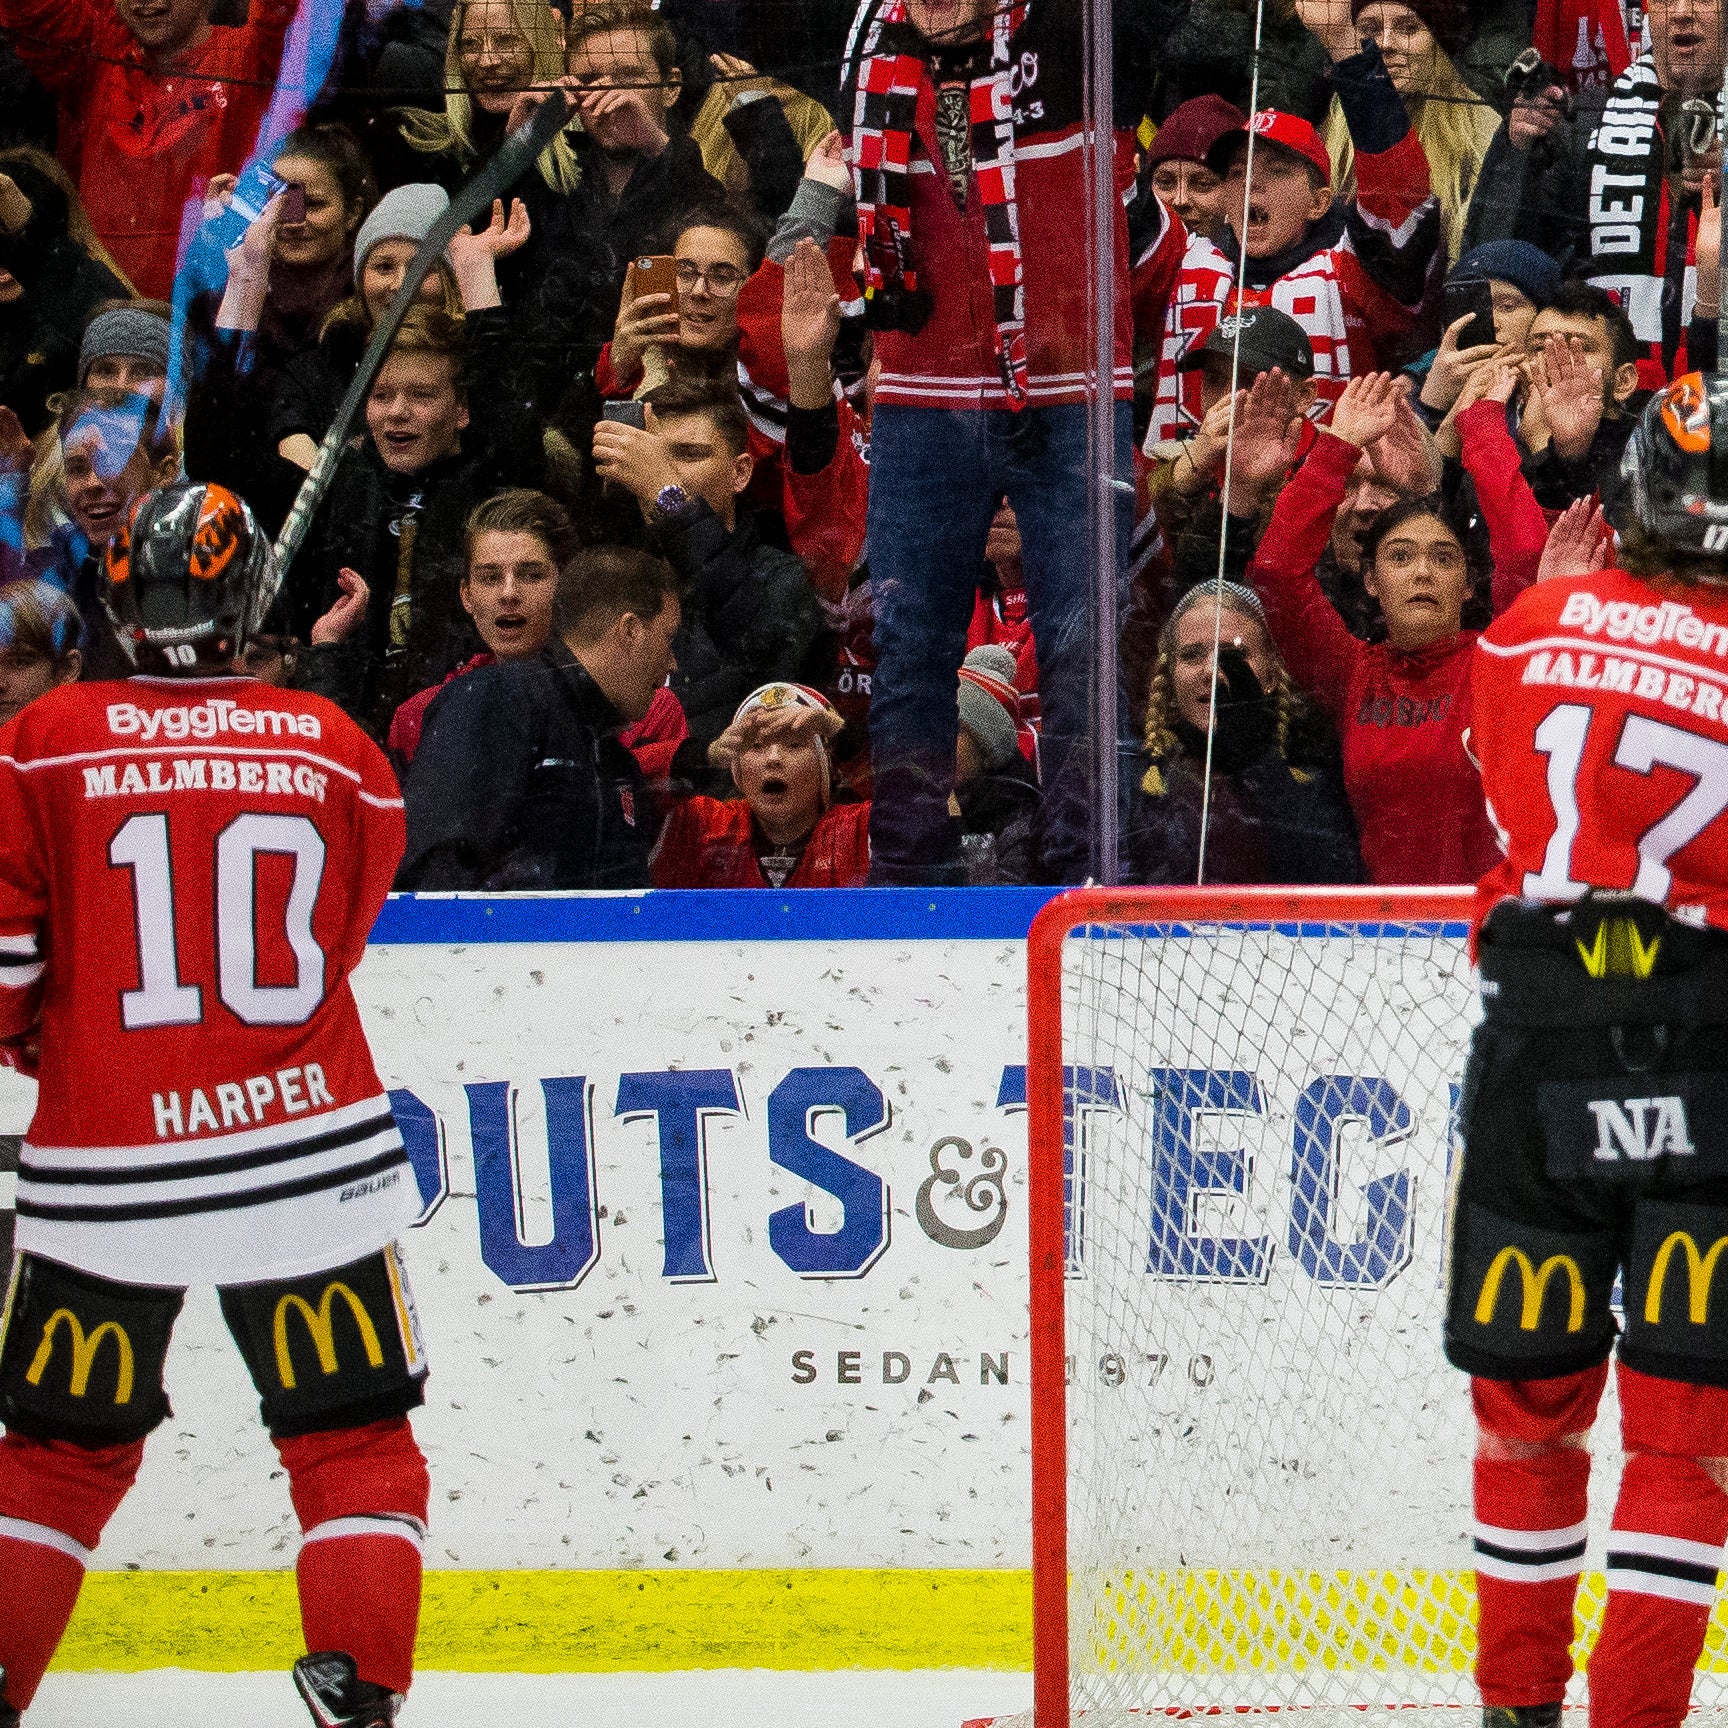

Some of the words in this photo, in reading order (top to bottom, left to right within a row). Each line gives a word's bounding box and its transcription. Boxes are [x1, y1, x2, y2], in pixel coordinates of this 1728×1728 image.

[1588, 165, 1646, 258] DET
[163, 645, 198, 668] 10
[107, 698, 321, 740] ByggTema
[84, 758, 328, 802] MALMBERGS
[108, 812, 327, 1031] 10
[152, 1062, 334, 1138] HARPER
[1587, 1095, 1697, 1162] NA
[390, 1065, 892, 1294] UTS
[915, 1134, 1008, 1251] &
[995, 1064, 1464, 1291] TEC
[790, 1350, 1010, 1387] SEDAN
